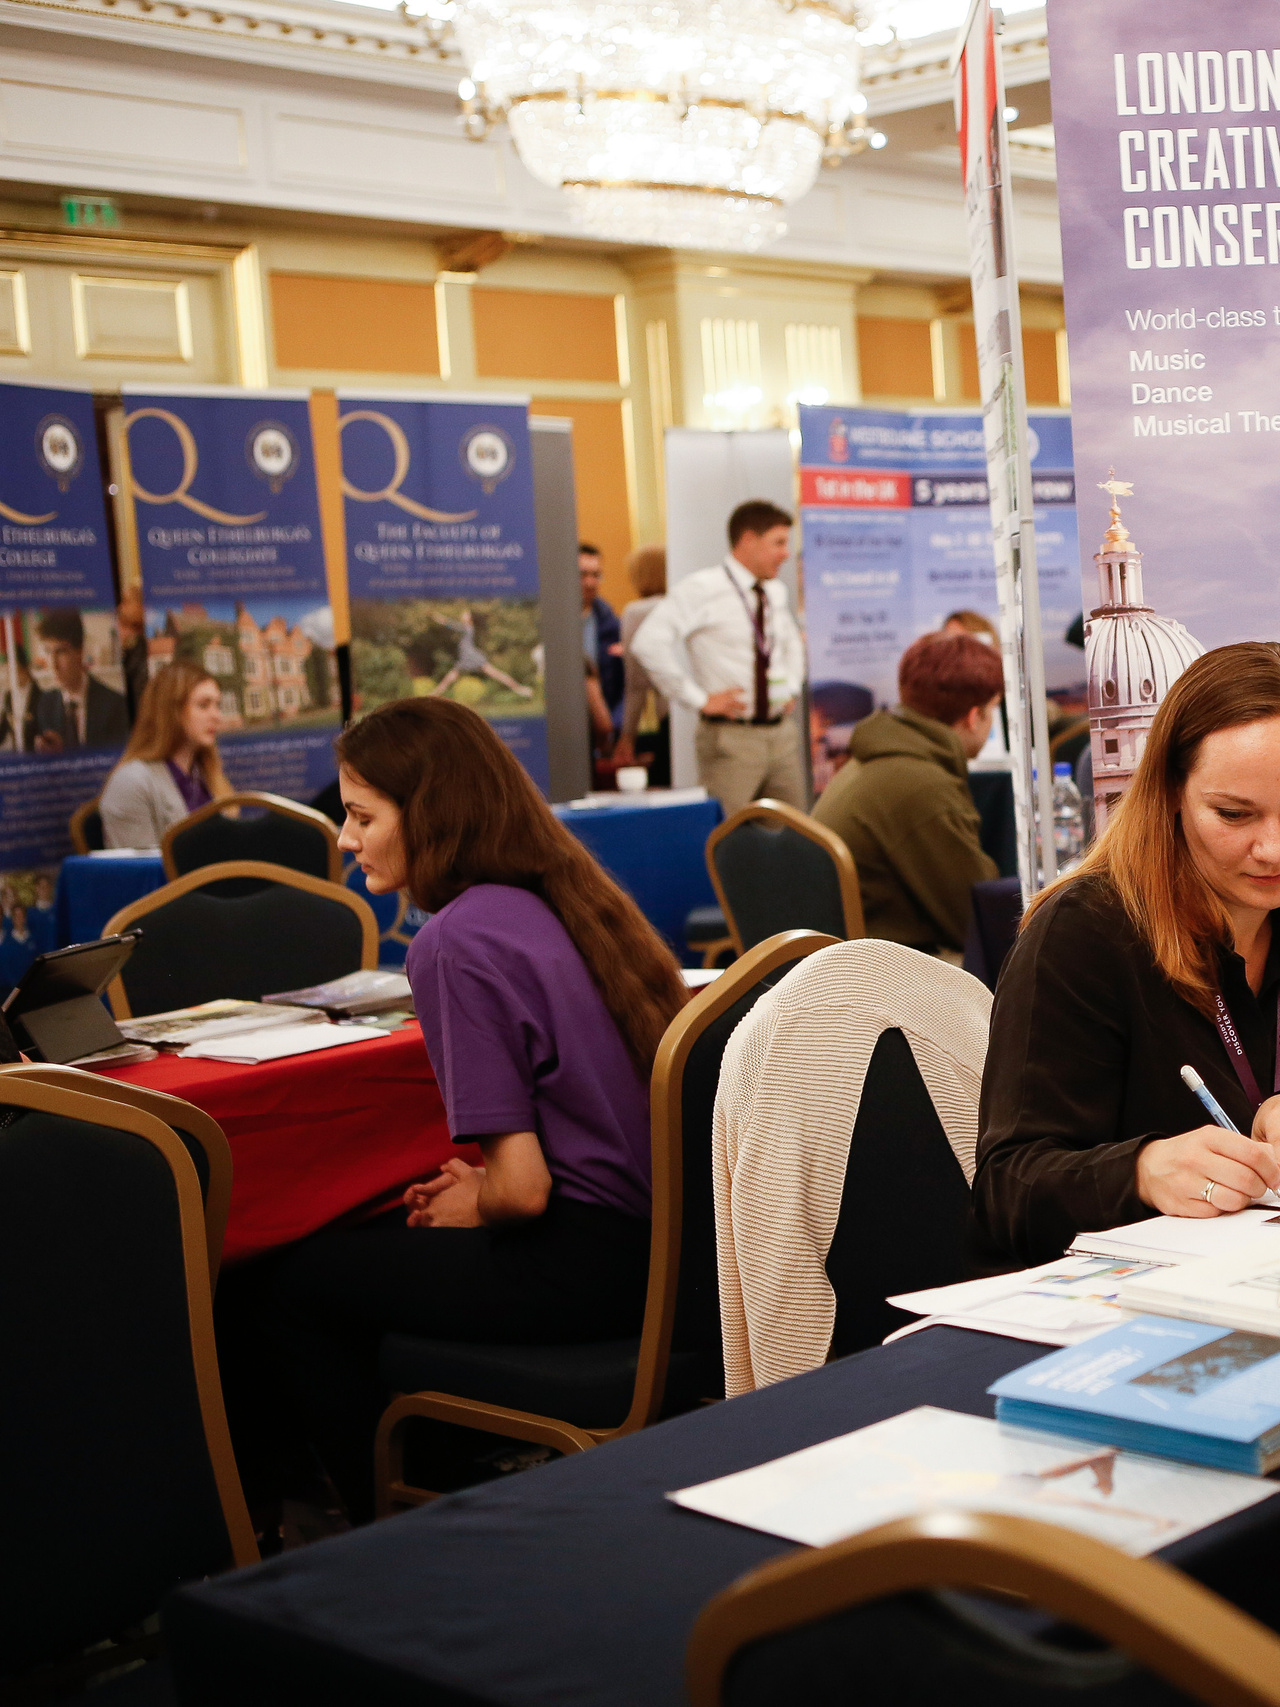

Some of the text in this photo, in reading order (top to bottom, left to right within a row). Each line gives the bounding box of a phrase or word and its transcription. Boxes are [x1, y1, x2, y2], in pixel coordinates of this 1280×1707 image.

[1125, 305, 1267, 331] World-class
[1129, 348, 1207, 372] Music
[1131, 382, 1214, 405] Dance
[1133, 412, 1231, 437] Musical
[1222, 1013, 1243, 1056] DISCOVER
